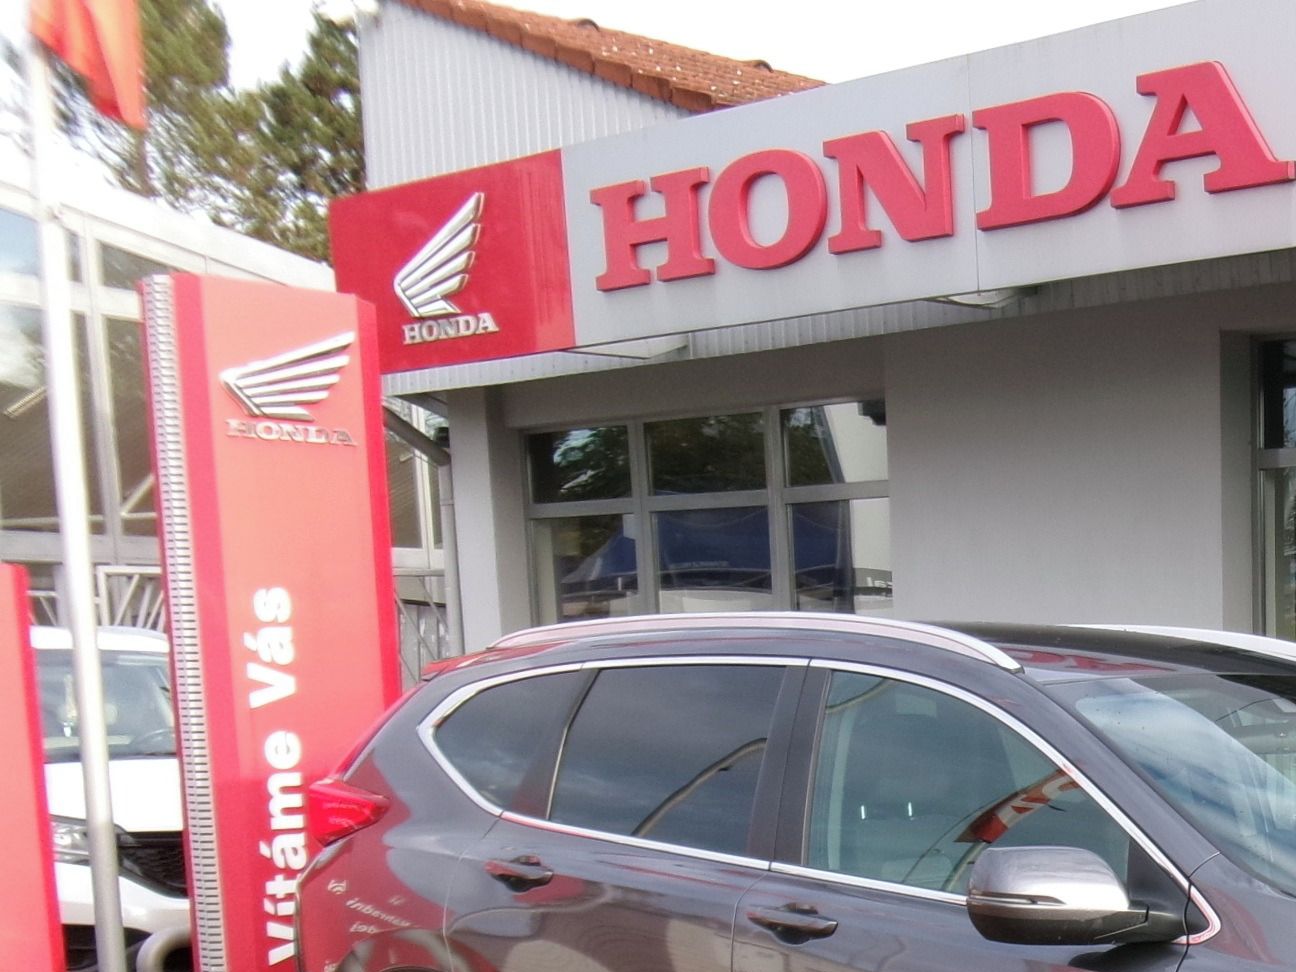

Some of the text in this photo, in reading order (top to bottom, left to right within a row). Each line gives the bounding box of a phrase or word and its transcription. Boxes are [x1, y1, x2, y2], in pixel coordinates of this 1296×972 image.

[590, 61, 1296, 291] HONDA
[402, 312, 499, 345] HONDA
[225, 419, 358, 446] HONDA
[243, 586, 309, 967] Vítáme Vás
